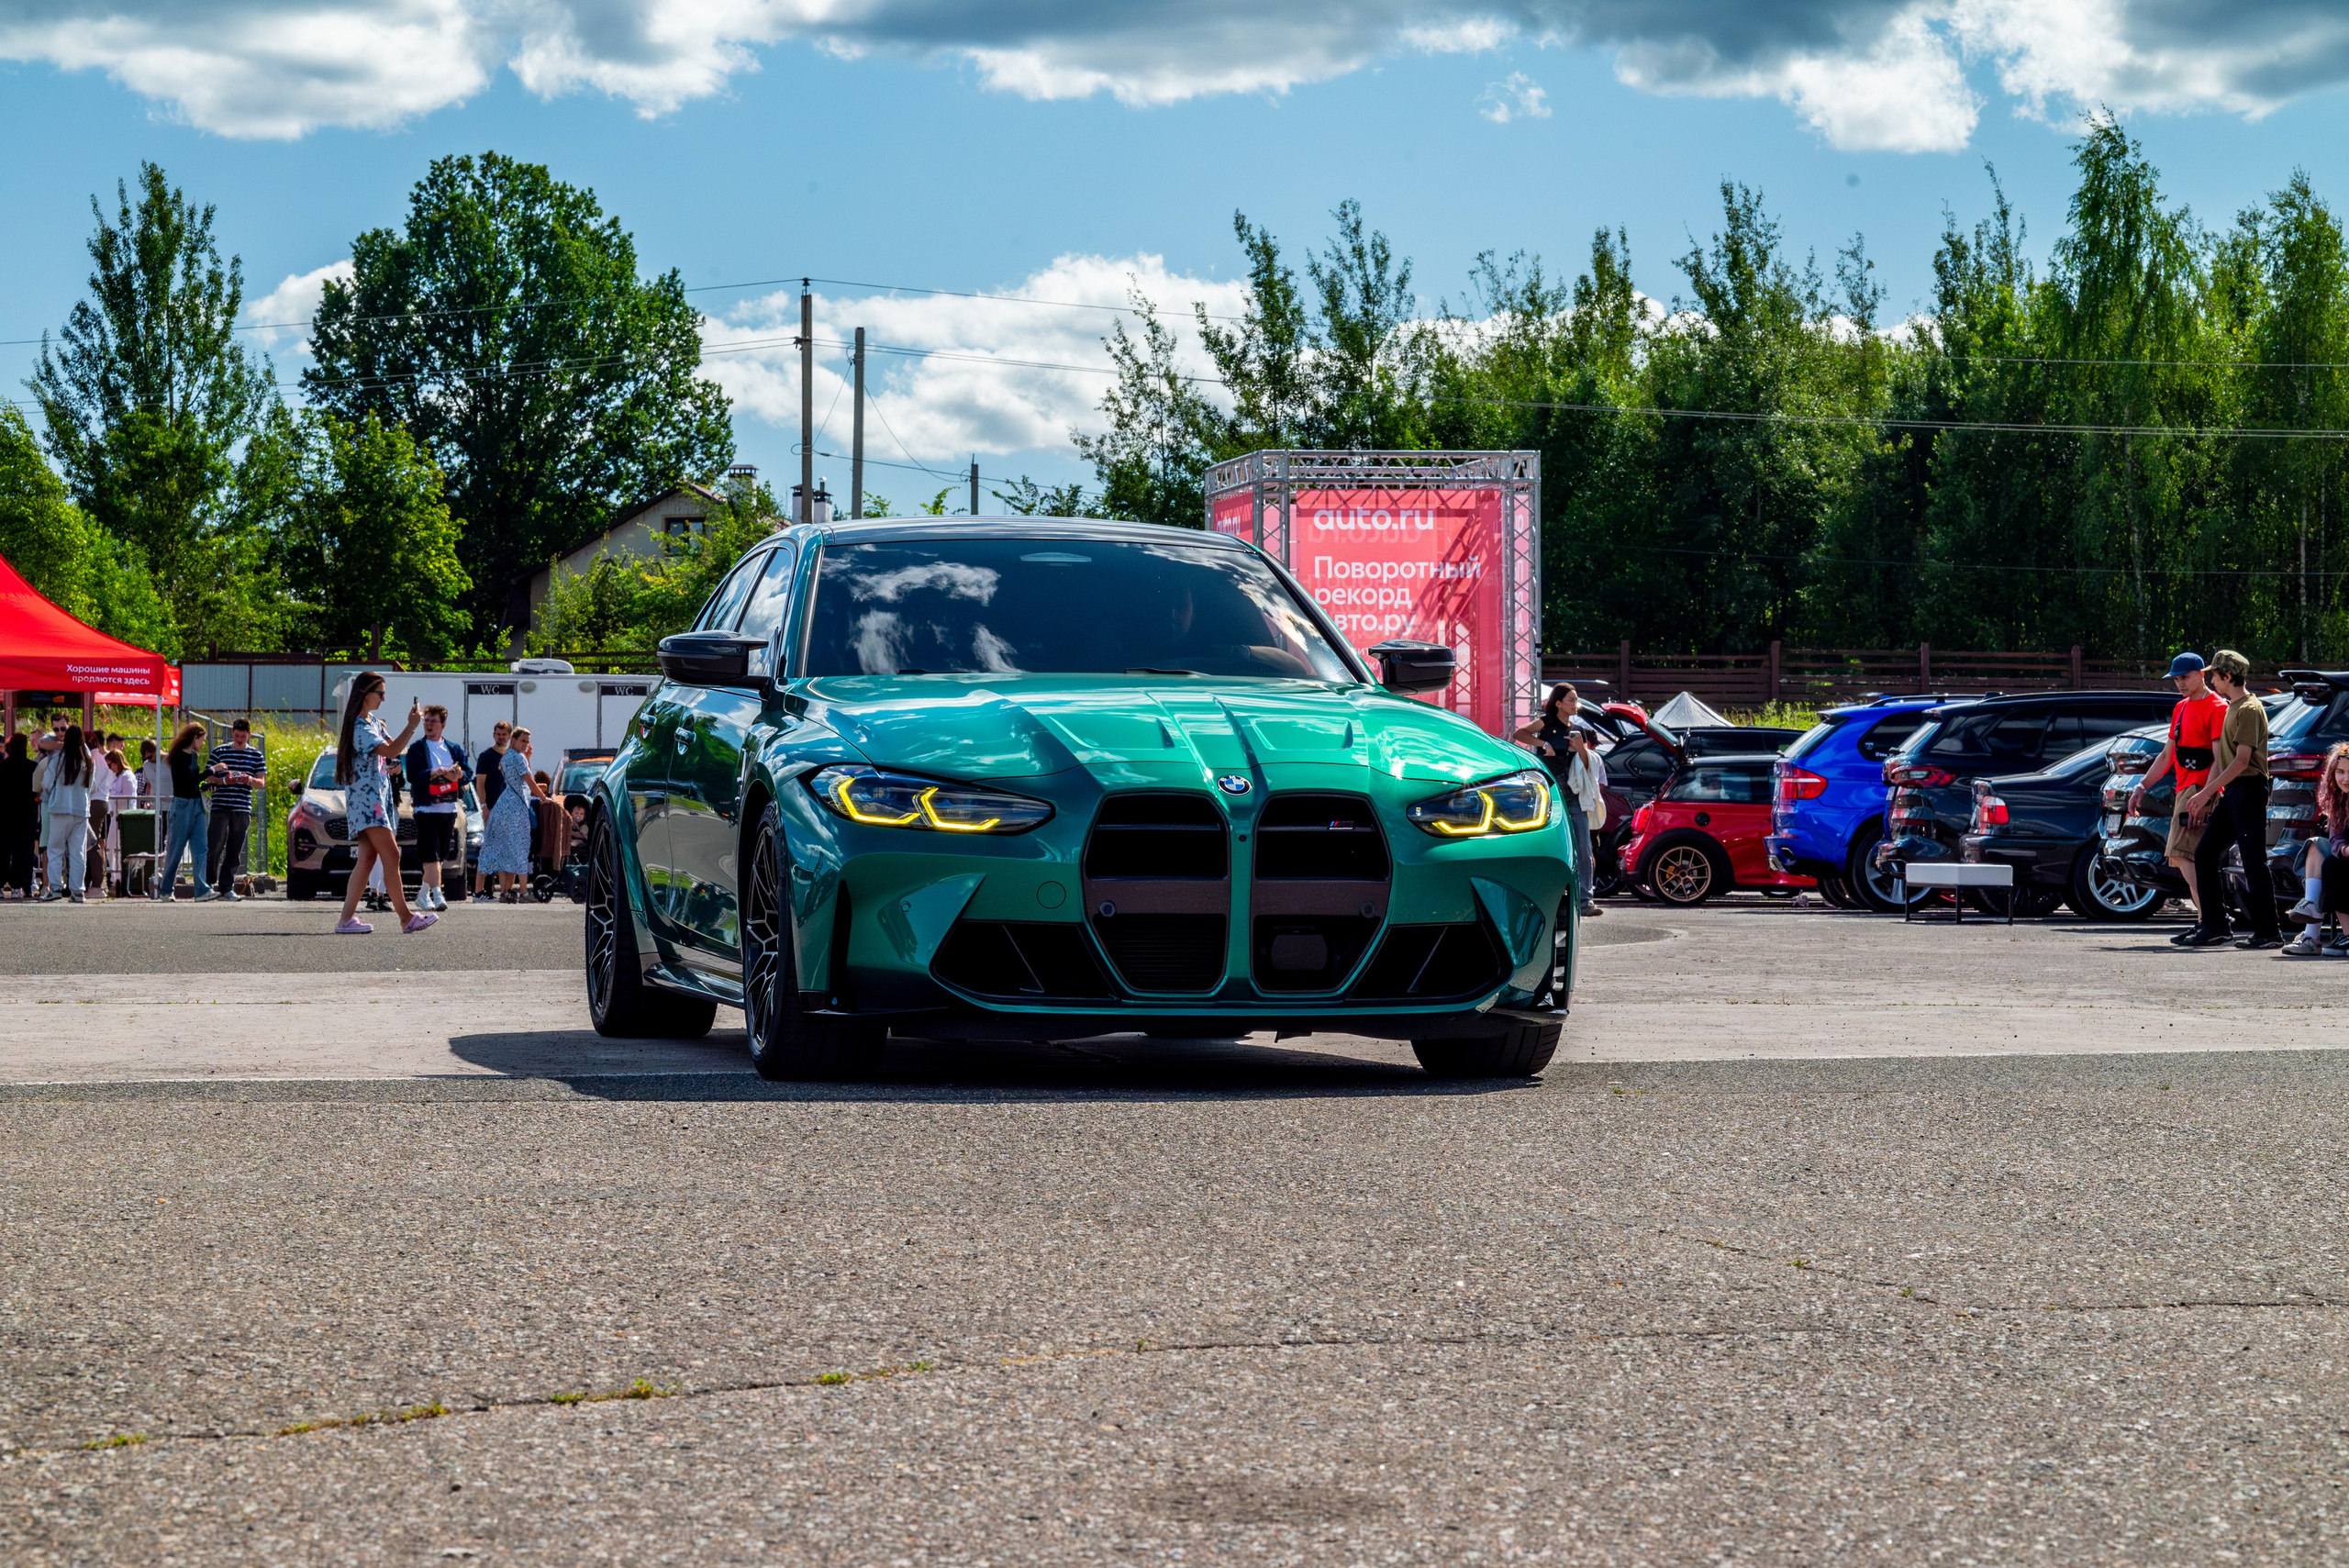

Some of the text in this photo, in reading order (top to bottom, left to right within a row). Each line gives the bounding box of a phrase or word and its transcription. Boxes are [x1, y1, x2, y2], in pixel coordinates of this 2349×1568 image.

[1313, 506, 1434, 530] auto.ru
[1314, 556, 1481, 584] Поворотный
[1315, 587, 1412, 609] рекорд
[1330, 612, 1416, 636] вто.ру
[66, 664, 109, 673] Хорошие
[72, 675, 150, 685] продаются здесь
[481, 684, 500, 695] WC
[615, 686, 634, 696] WC
